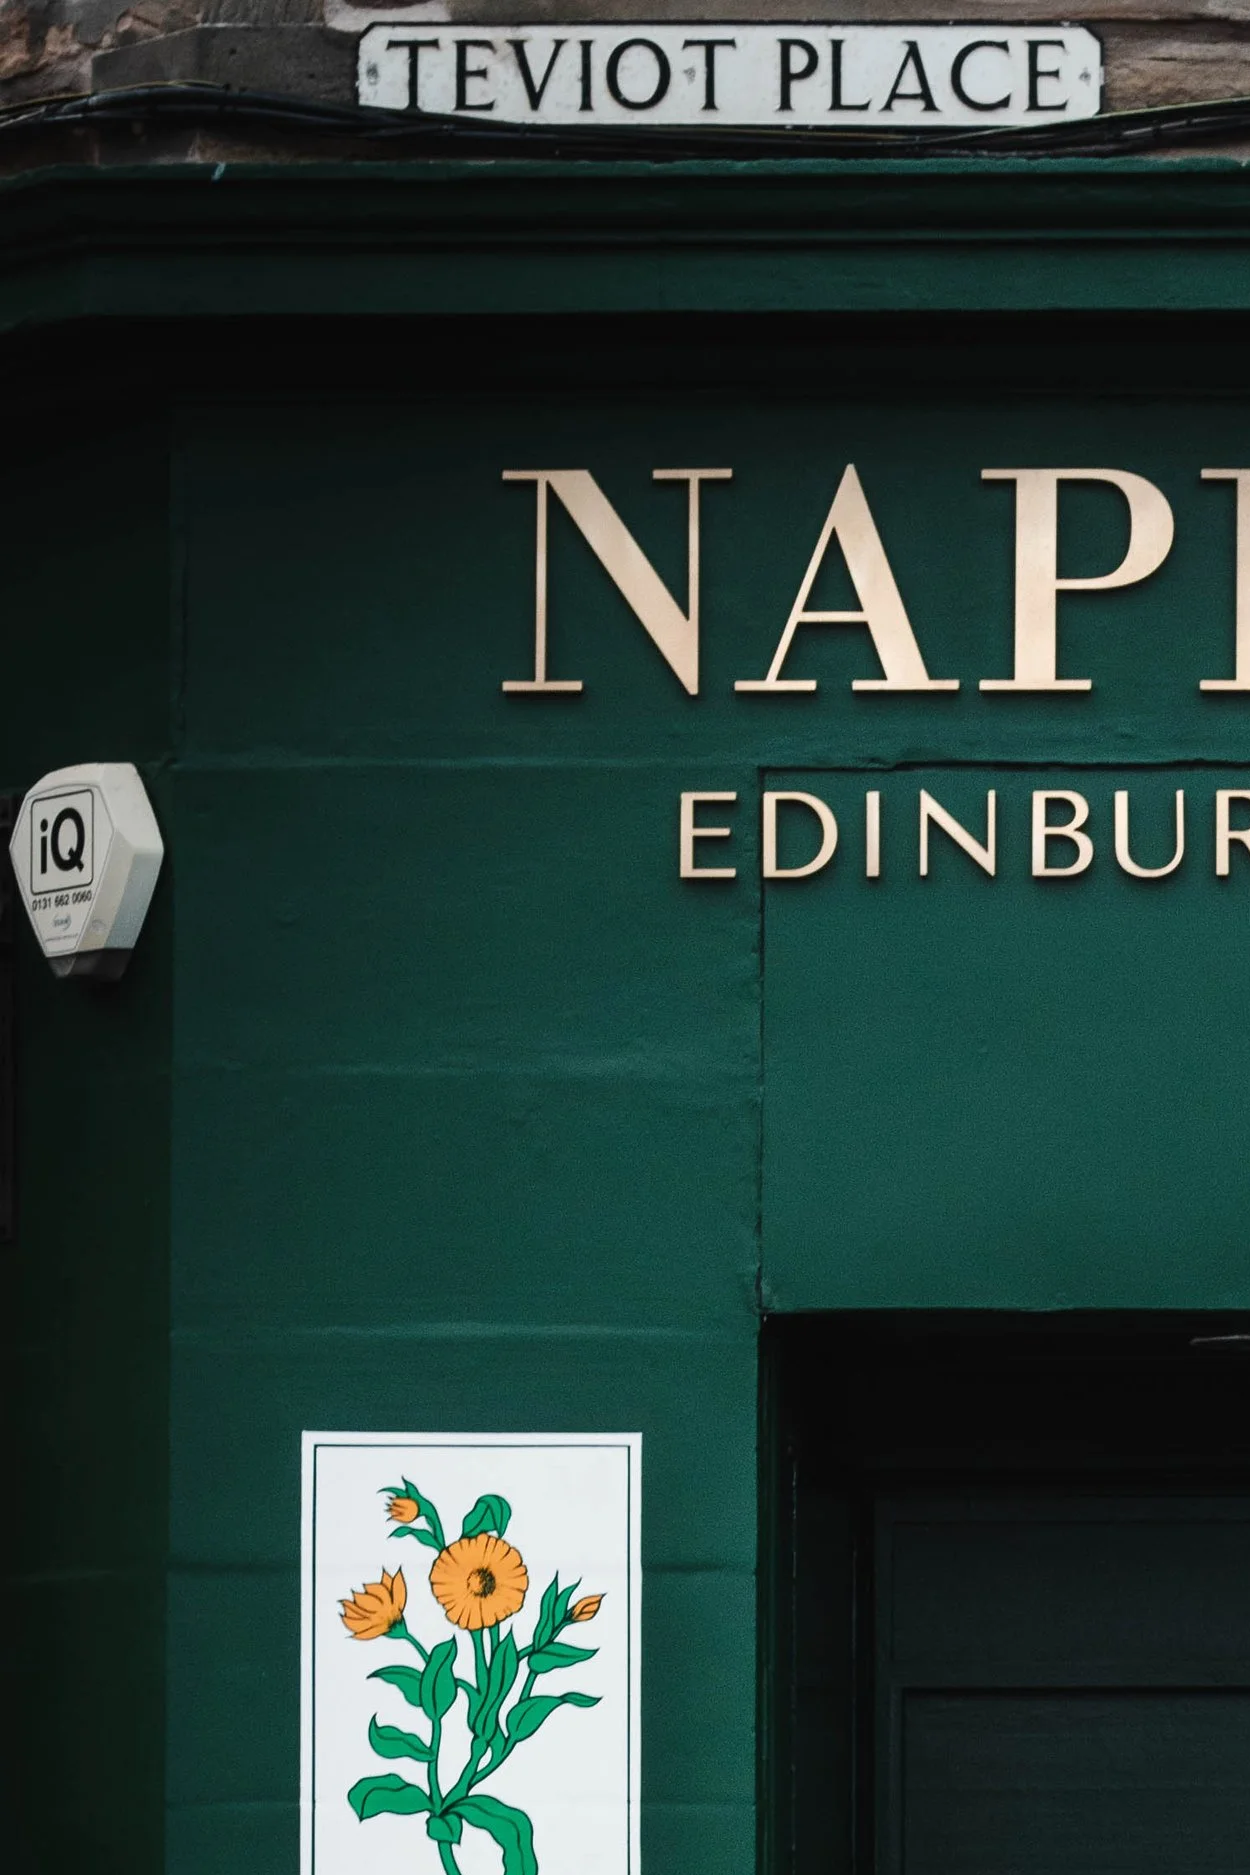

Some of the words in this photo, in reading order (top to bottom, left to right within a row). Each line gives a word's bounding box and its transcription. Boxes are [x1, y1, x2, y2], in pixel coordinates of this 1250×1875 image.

[386, 38, 736, 112] TEVIOT
[777, 39, 1067, 112] PLACE
[40, 808, 85, 874] iQ
